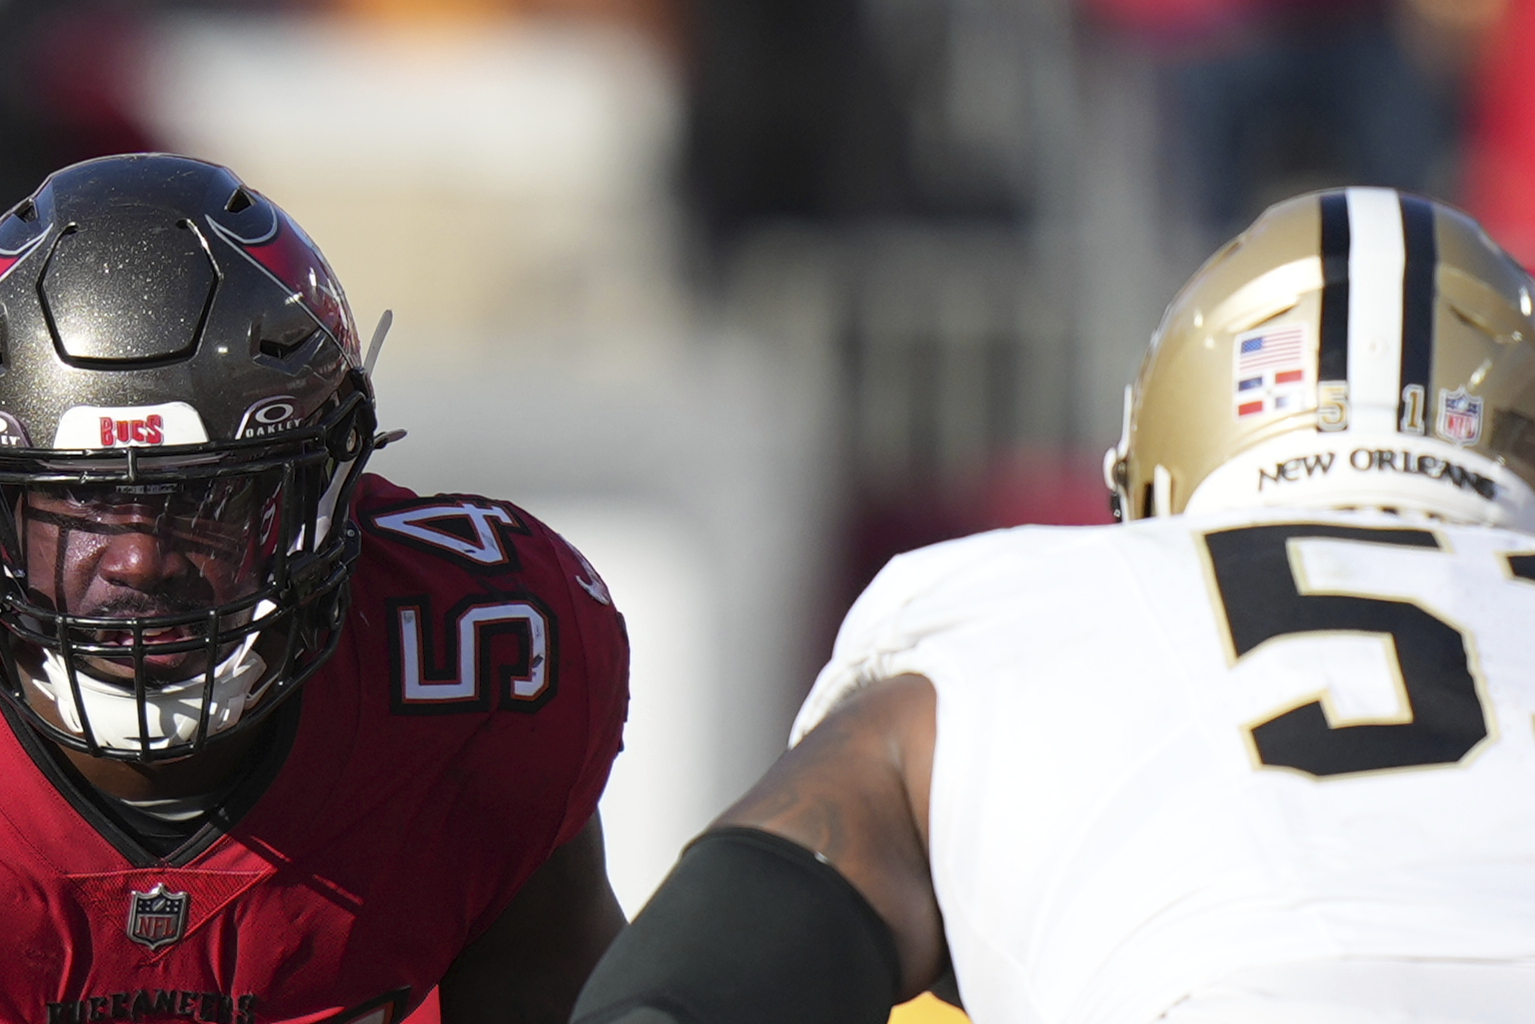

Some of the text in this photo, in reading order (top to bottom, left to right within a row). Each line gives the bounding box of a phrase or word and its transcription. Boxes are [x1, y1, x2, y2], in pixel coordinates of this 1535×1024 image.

[99, 414, 164, 448] BUCS
[246, 418, 302, 438] OAKLEY
[1258, 452, 1335, 491] NEW
[359, 498, 560, 715] 54
[136, 916, 176, 937] NFL
